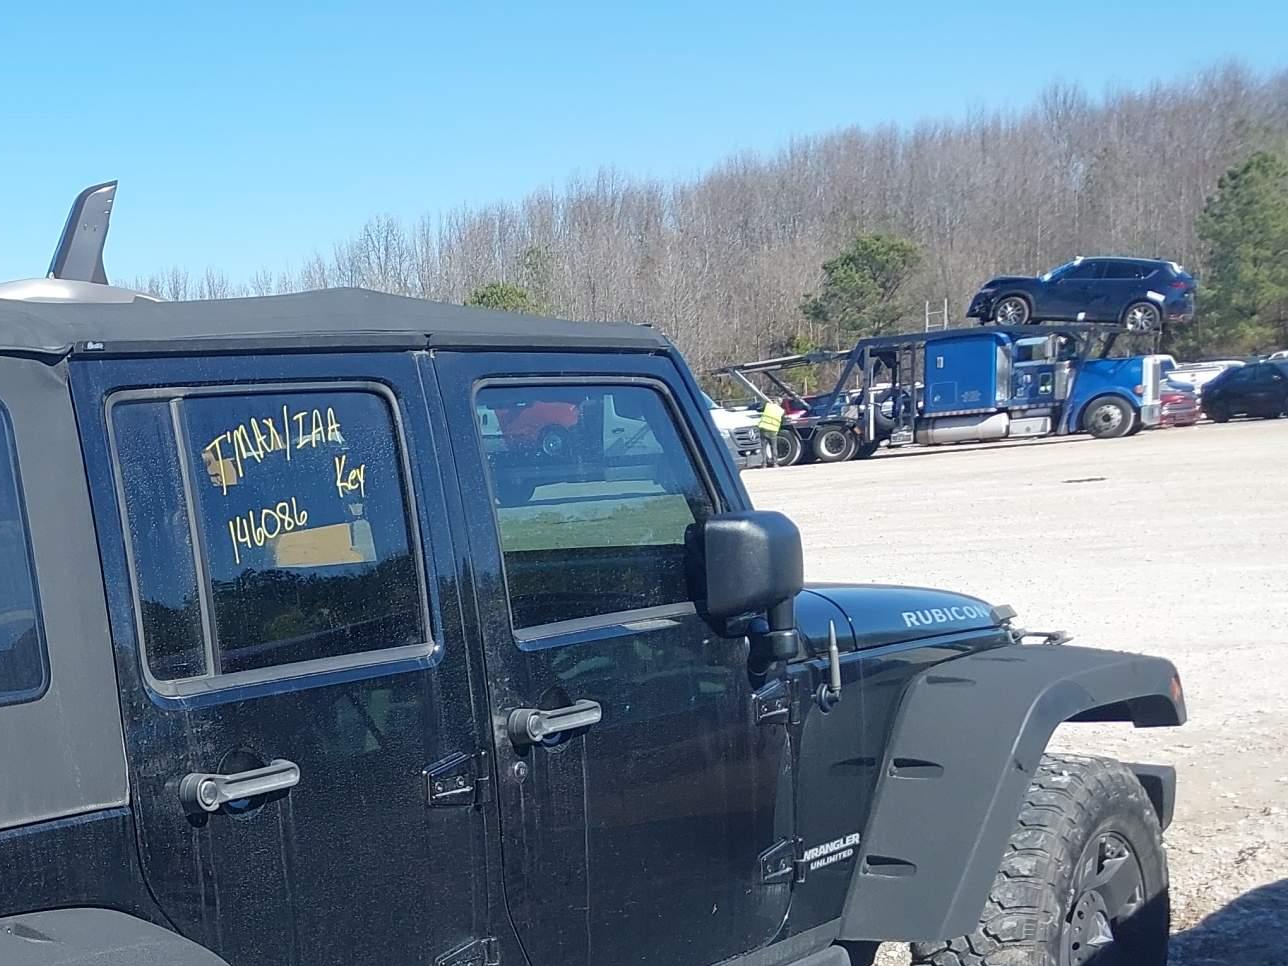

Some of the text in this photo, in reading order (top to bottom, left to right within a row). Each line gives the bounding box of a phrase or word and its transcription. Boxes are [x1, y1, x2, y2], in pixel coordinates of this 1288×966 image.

[334, 454, 366, 498] Key
[228, 496, 308, 565] 146086
[901, 604, 991, 628] RUBICON
[810, 848, 854, 870] UNLIMITED
